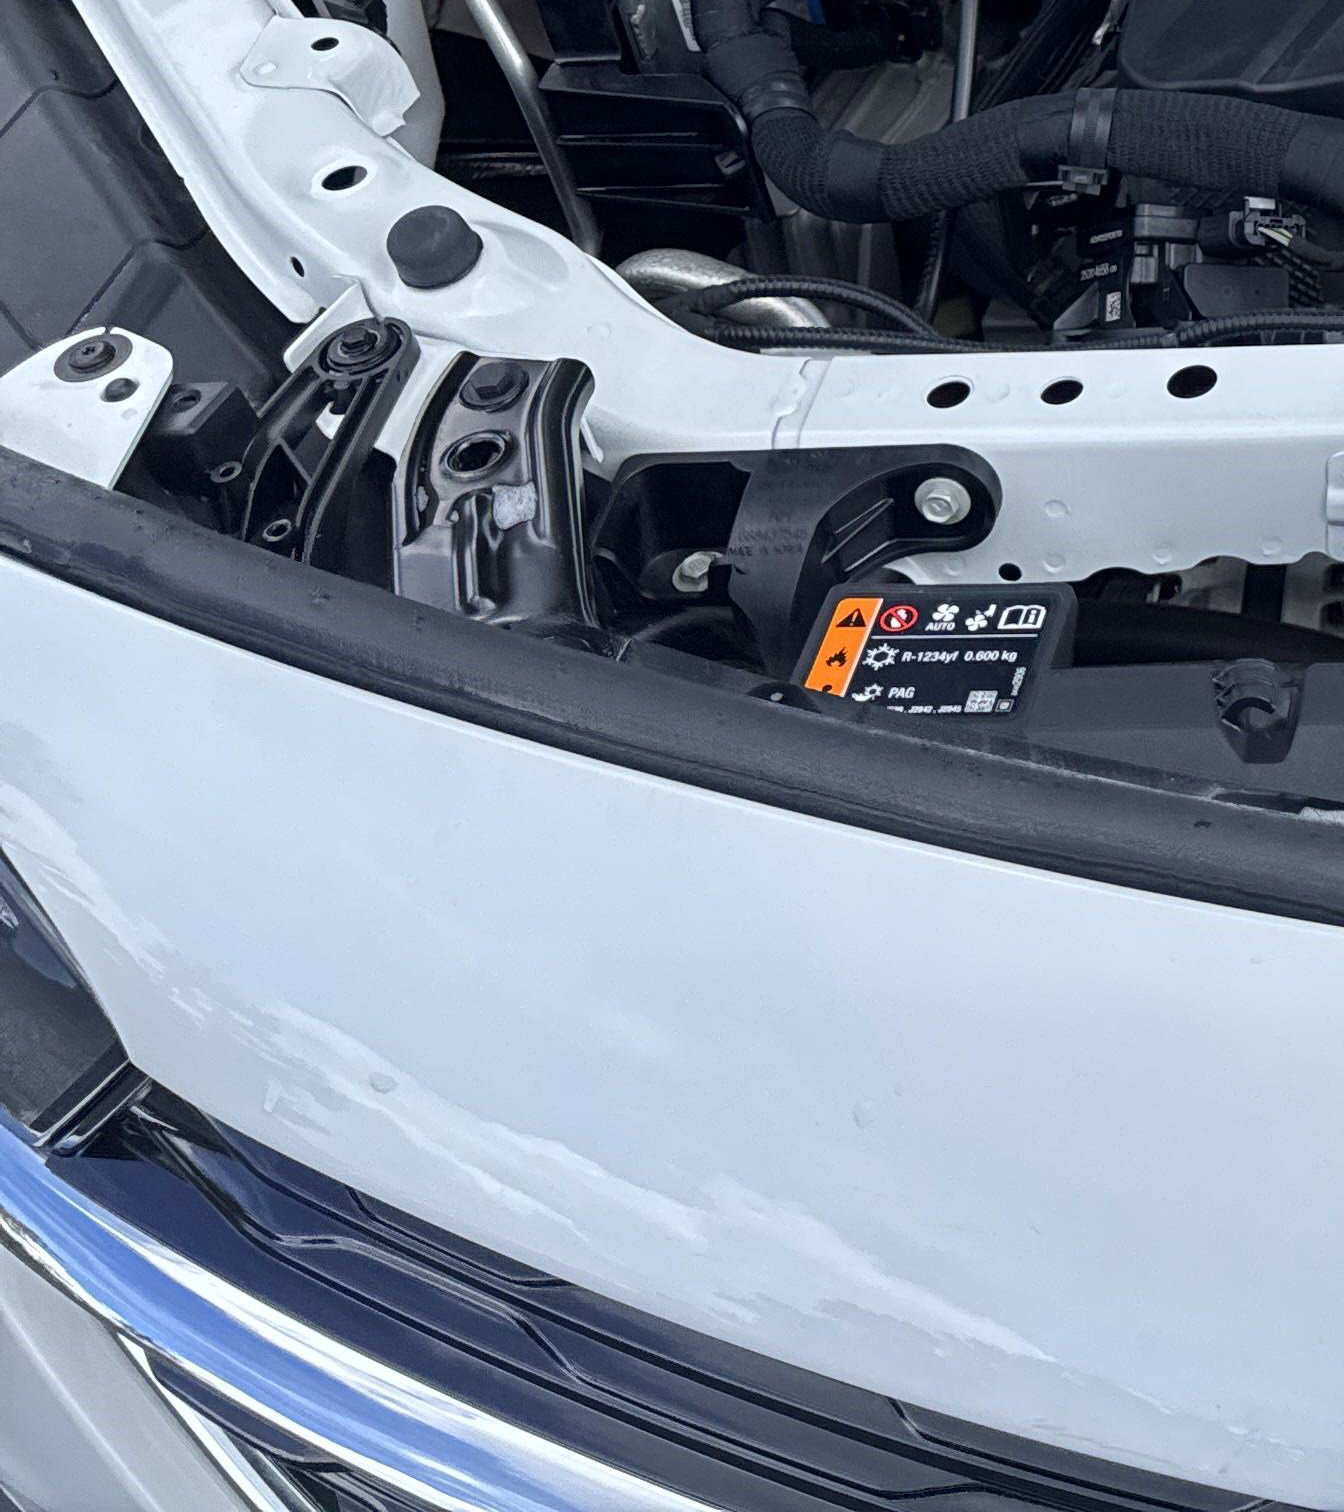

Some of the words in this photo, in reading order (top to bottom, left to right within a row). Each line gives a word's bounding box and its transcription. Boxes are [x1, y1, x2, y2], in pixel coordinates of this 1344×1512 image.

[925, 621, 956, 632] AUTO
[901, 651, 960, 664] R-1234yf
[963, 650, 1000, 662] 0.600
[1001, 650, 1018, 663] kg
[888, 686, 916, 699] PAG
